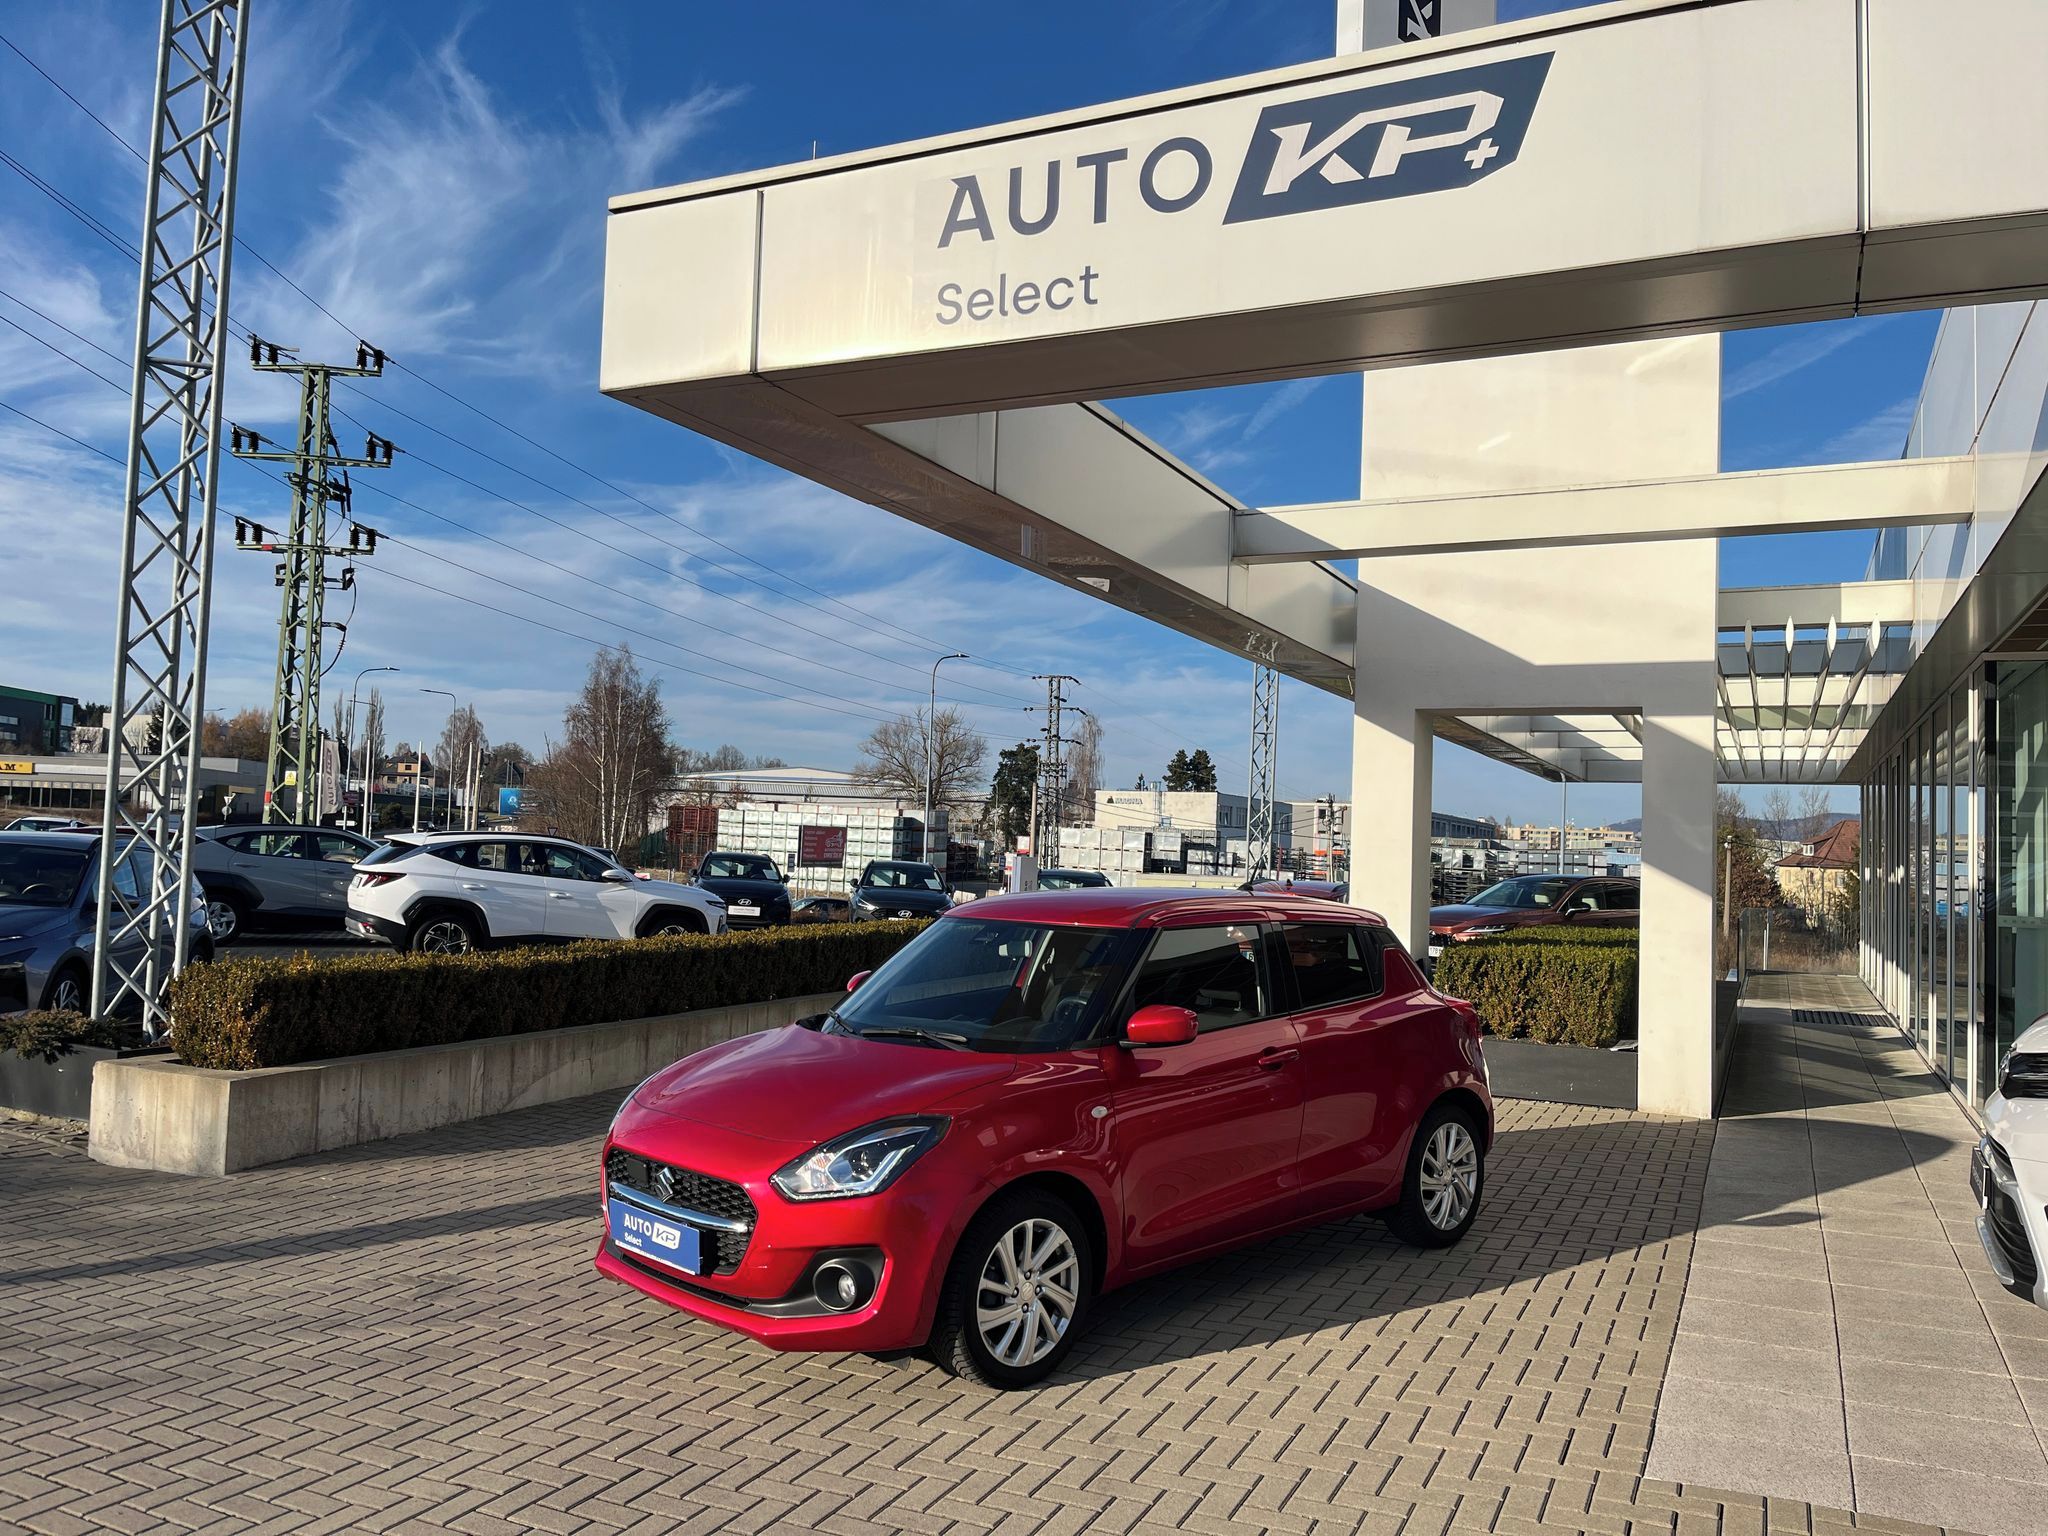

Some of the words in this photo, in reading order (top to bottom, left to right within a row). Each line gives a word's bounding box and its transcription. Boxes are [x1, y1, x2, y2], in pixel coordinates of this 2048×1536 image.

[936, 135, 1213, 249] AUTO
[936, 265, 1099, 325] Select
[624, 1213, 652, 1236] AUTO
[624, 1232, 643, 1247] Select
